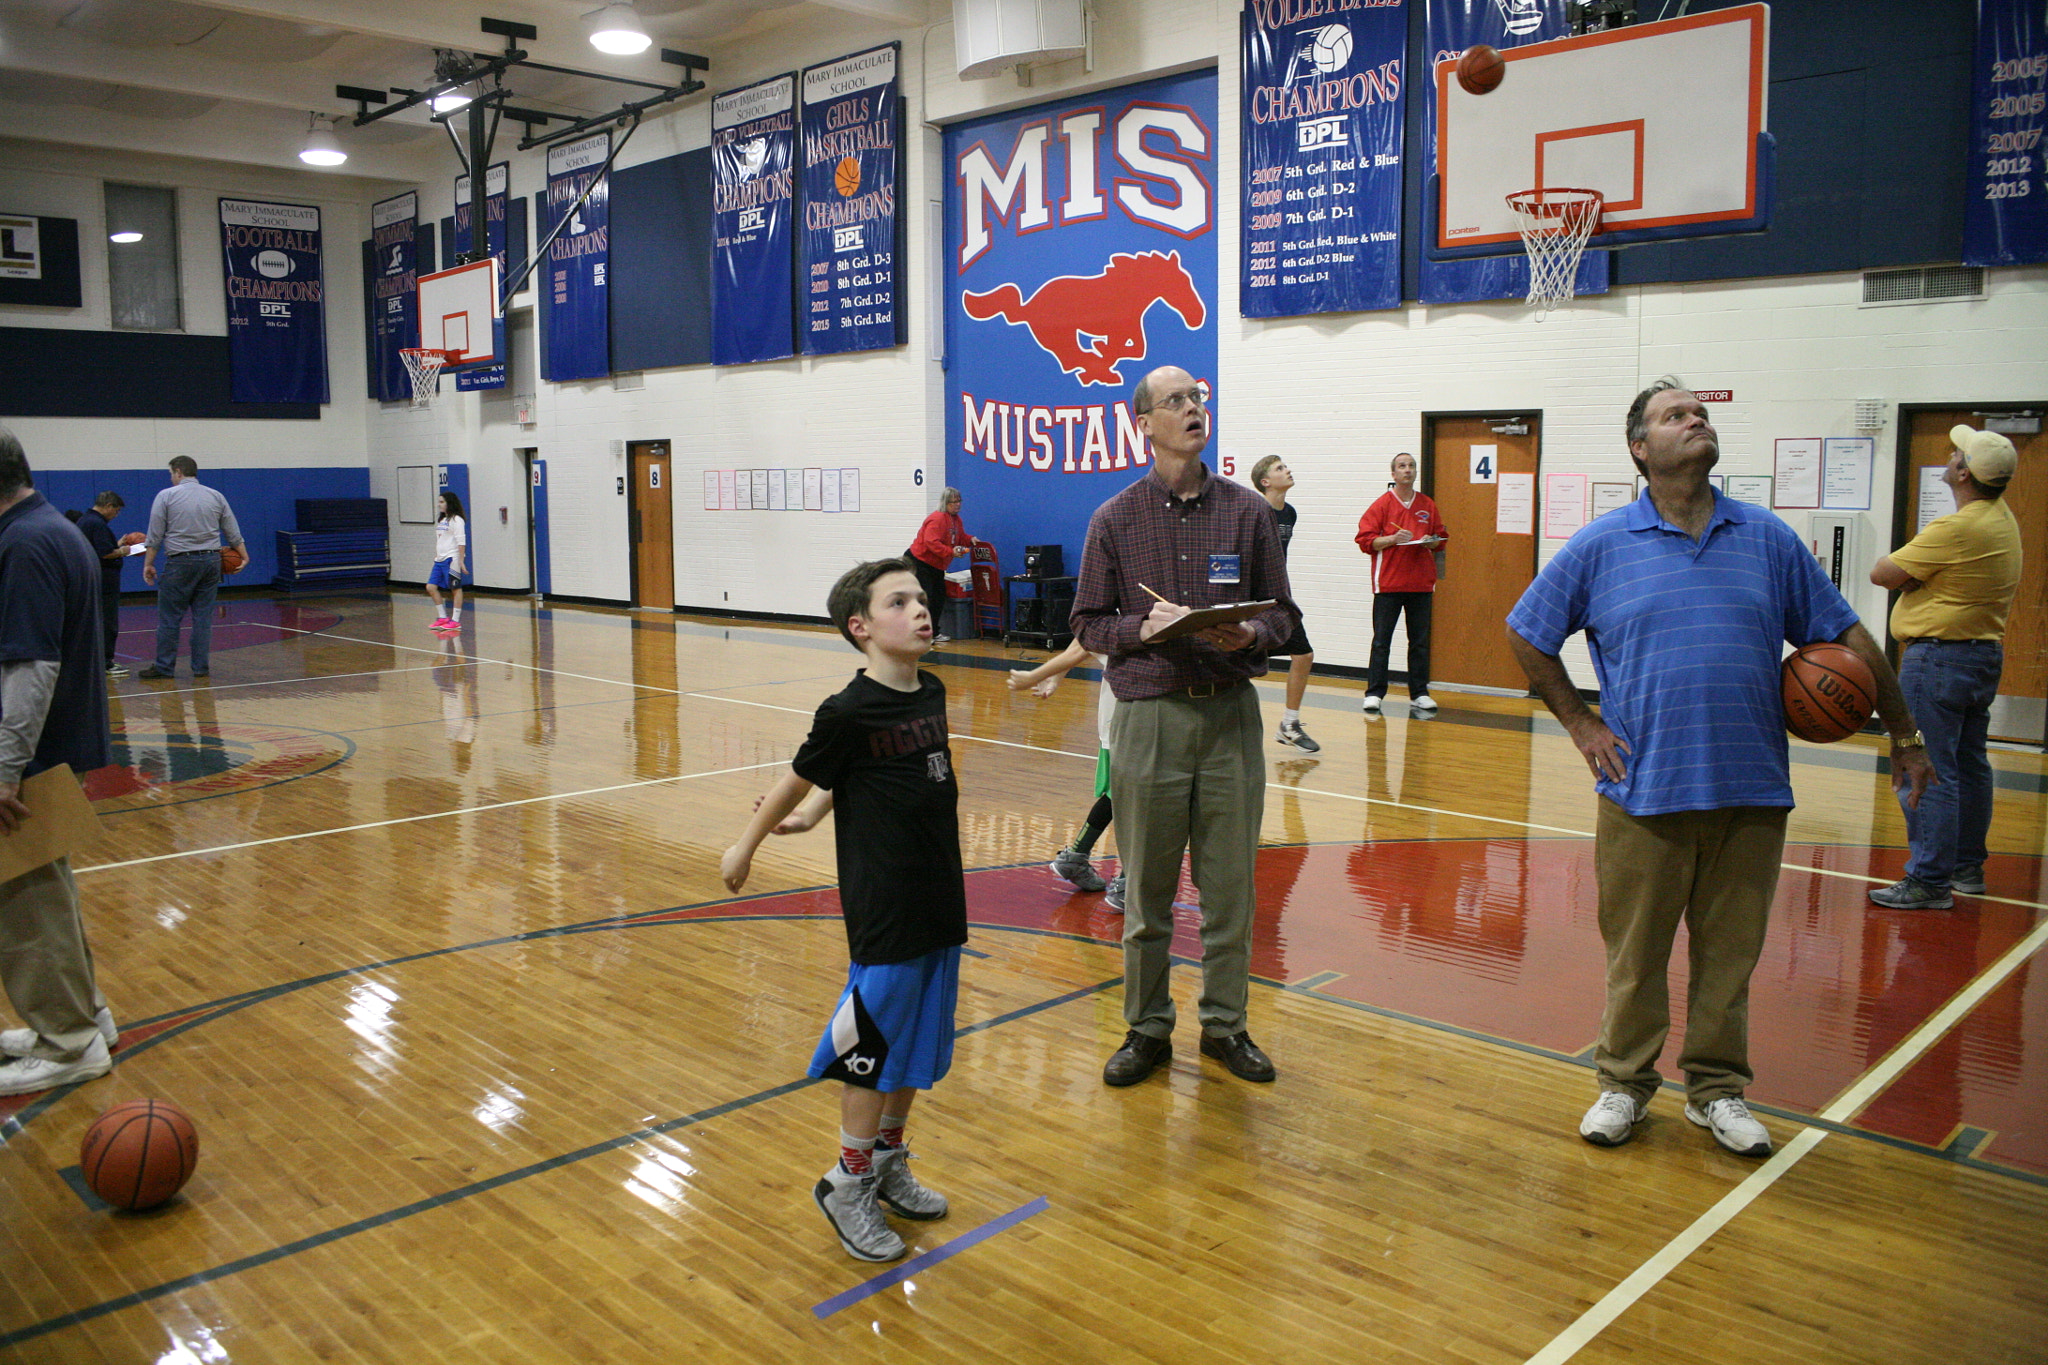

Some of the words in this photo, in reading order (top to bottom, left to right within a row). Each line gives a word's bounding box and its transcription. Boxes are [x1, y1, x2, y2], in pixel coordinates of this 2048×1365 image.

[1253, 0, 1401, 35] VOLLE
[807, 69, 832, 86] MARY
[834, 51, 892, 78] IMMACULATE
[1991, 54, 2048, 82] 2005
[716, 97, 739, 113] MARY
[740, 82, 789, 106] IMMACULATE
[830, 76, 867, 96] SCHOOL
[1252, 59, 1400, 124] CHAMPIONS
[737, 103, 768, 121] SCHOOL
[826, 97, 869, 131] GIRLS
[1989, 92, 2046, 119] 2005
[806, 118, 893, 167] BASKETBALL
[1299, 121, 1348, 147] DPL
[1987, 127, 2043, 154] 2007
[1252, 165, 1283, 184] 2007
[1285, 166, 1303, 178] 5th
[1306, 162, 1327, 176] Grd.
[1332, 158, 1355, 171] Red
[1359, 157, 1370, 169] &
[1374, 154, 1399, 166] Blue
[1986, 156, 2032, 176] 2012
[713, 165, 793, 214] CHAMPIONS
[956, 99, 1212, 277] MIS
[1252, 189, 1283, 207] 2009
[1286, 188, 1304, 201] 6th
[1307, 185, 1327, 198] Grd.
[1332, 182, 1355, 195] D-2
[1985, 180, 2030, 200] 2013
[225, 203, 253, 214] MARY
[255, 205, 315, 219] IMMACULATE
[457, 196, 505, 233] SWING
[806, 183, 893, 231] CHAMPIONS
[1252, 212, 1282, 230] 2009
[1286, 212, 1304, 225] 7th
[1307, 208, 1327, 222] Grd.
[1331, 206, 1354, 218] D-1
[251, 215, 290, 227] SCHOOL
[739, 212, 766, 228] DPL
[225, 225, 318, 254] FOOTBALL
[551, 225, 608, 262] CHAMPIONS
[834, 229, 865, 249] DPL
[1251, 240, 1276, 254] 2011
[1282, 241, 1297, 252] 5th
[1337, 235, 1359, 245] Blue
[1360, 234, 1369, 243] &
[1370, 231, 1397, 242] White
[837, 259, 850, 272] 8th
[852, 255, 871, 269] Grd.
[874, 252, 891, 266] D-3
[1250, 256, 1276, 271] 2012
[1282, 258, 1297, 268] 6th
[1316, 253, 1330, 264] D-2
[1332, 252, 1355, 263] Blue
[227, 276, 321, 302] CHAMPIONS
[837, 277, 850, 290] 8th
[852, 273, 872, 287] Grd.
[875, 271, 891, 284] D-1
[1250, 274, 1276, 288] 2014
[1282, 275, 1297, 285] 8th
[1316, 271, 1329, 282] D-1
[260, 303, 292, 315] DPL
[388, 299, 402, 312] DPL
[840, 297, 852, 309] 7th
[854, 294, 873, 307] Grd.
[875, 292, 890, 304] D-2
[230, 317, 249, 326] 2012
[840, 317, 852, 328] 5th
[854, 314, 874, 326] Grd.
[875, 310, 891, 324] Red
[961, 378, 1212, 474] MUSTAN
[533, 471, 540, 484] 9
[914, 469, 923, 486] 6
[1223, 456, 1235, 476] 5
[1475, 456, 1492, 479] 4
[439, 472, 448, 485] 10
[652, 472, 658, 486] 8
